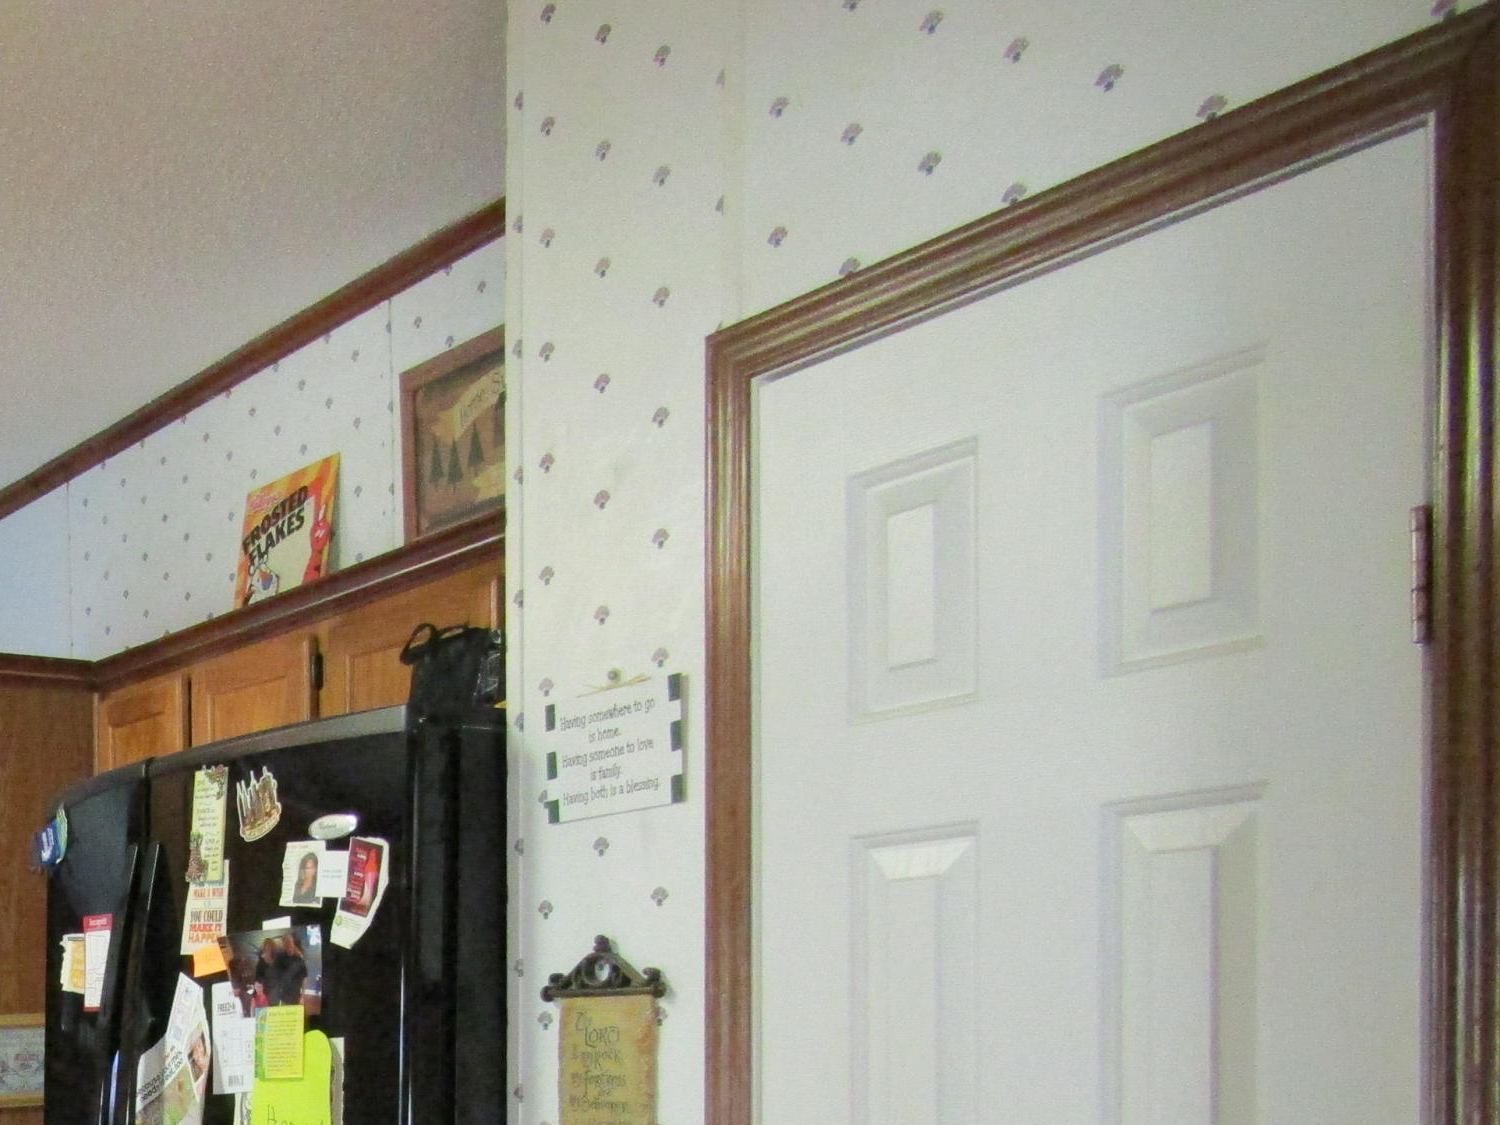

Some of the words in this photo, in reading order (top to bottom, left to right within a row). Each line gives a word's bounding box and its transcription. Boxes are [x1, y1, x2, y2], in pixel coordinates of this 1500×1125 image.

[249, 507, 305, 567] FLAKES
[560, 714, 586, 731] Having
[588, 704, 632, 724] somewhere
[633, 700, 642, 712] to
[644, 698, 655, 713] go
[588, 731, 596, 743] is
[562, 752, 588, 769] Having
[589, 745, 625, 763] someone
[626, 741, 635, 753] to
[637, 737, 654, 753] love
[562, 790, 589, 806] Having
[590, 785, 608, 802] both
[610, 781, 618, 793] is
[203, 909, 223, 923] COULD
